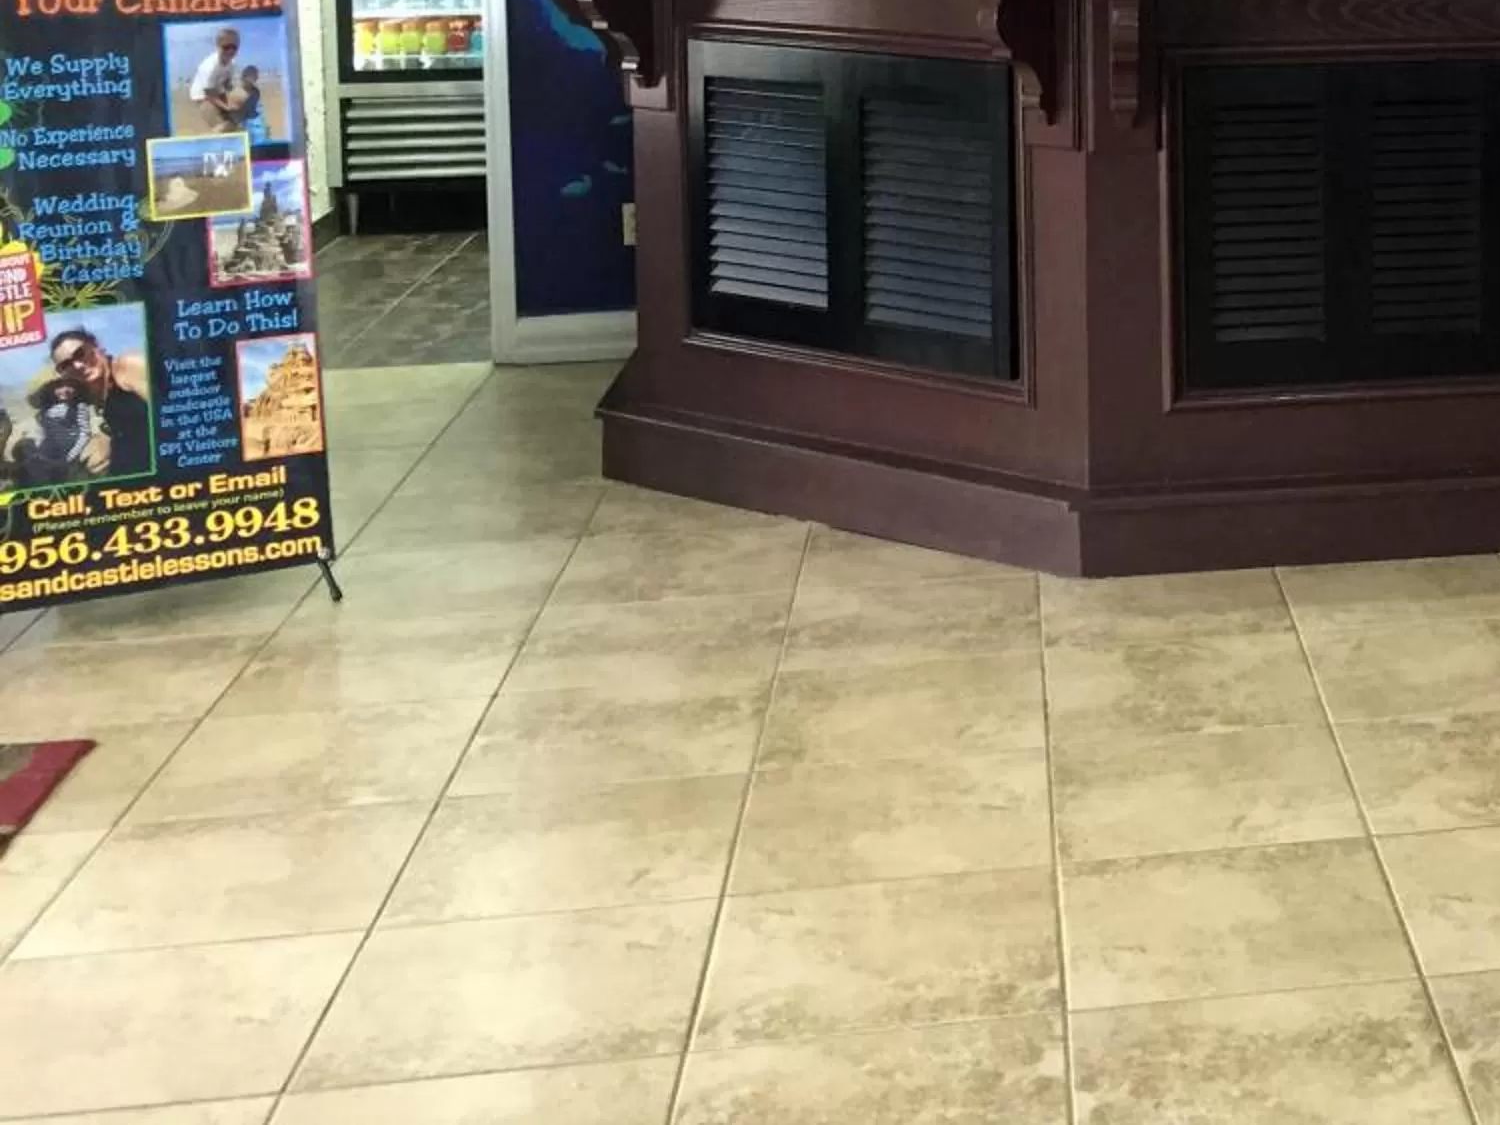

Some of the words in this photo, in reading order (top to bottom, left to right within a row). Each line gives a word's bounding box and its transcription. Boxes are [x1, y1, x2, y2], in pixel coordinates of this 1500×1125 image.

[5, 56, 43, 76] We
[50, 51, 130, 81] Supply
[2, 78, 133, 102] Everything
[0, 128, 29, 148] No
[33, 124, 135, 150] Experience
[17, 148, 137, 172] Necessary
[17, 219, 113, 240] Reunion
[120, 209, 140, 231] &
[40, 237, 142, 263] Birthday
[62, 262, 145, 284] Castles
[175, 297, 240, 318] Learn
[243, 289, 294, 311] How
[173, 319, 203, 342] To
[207, 317, 240, 339] Do
[244, 306, 299, 332] This!
[164, 358, 197, 372] Visit
[200, 355, 223, 368] the
[171, 370, 218, 388] largest
[168, 384, 221, 400] outdoor
[161, 396, 231, 414] sandcastle
[161, 415, 174, 428] in
[177, 413, 201, 427] the
[203, 407, 233, 423] USA
[177, 429, 194, 440] at
[195, 424, 218, 437] the
[184, 437, 238, 452] Visitors
[177, 452, 224, 468] Center
[28, 492, 92, 520] Call,
[99, 484, 164, 510] Text
[169, 479, 203, 500] or
[209, 465, 287, 494] Email
[157, 505, 172, 516] to
[0, 496, 321, 574] 956.433.9948
[0, 535, 322, 603] sandcastlelessons.com
